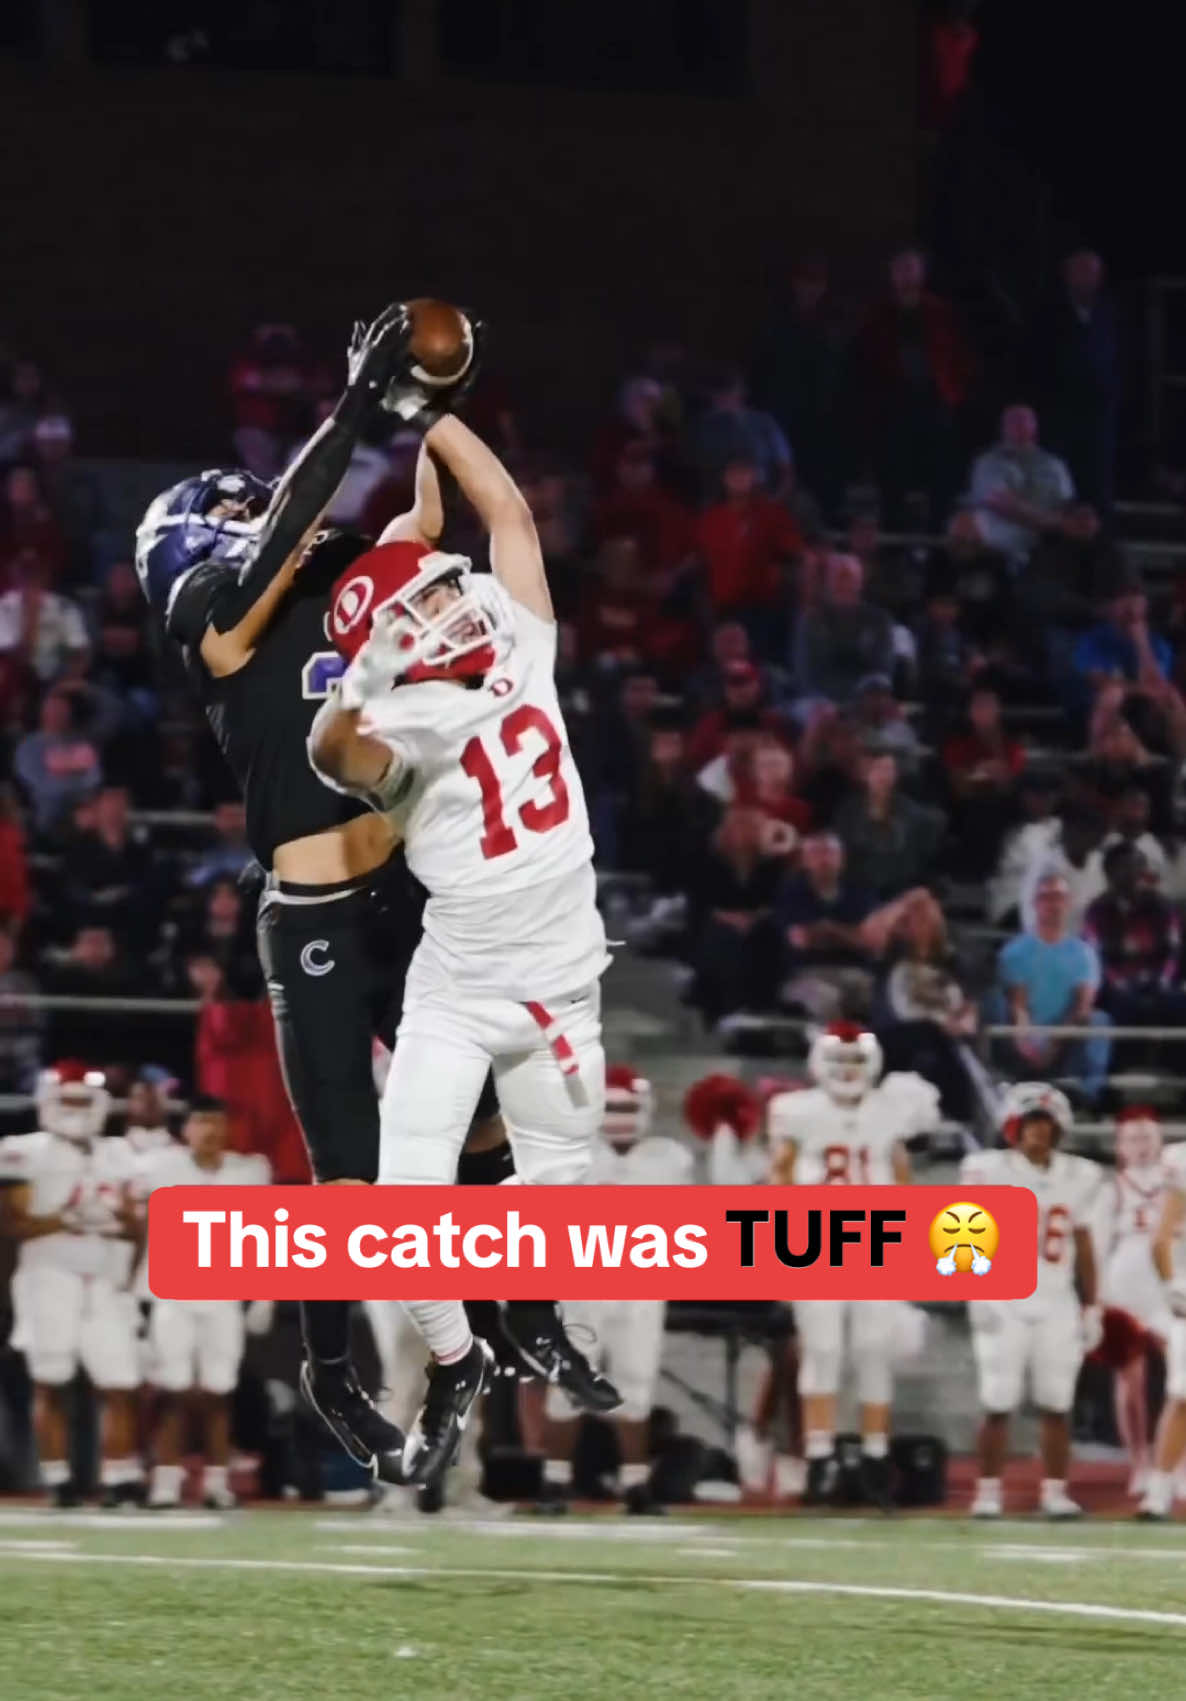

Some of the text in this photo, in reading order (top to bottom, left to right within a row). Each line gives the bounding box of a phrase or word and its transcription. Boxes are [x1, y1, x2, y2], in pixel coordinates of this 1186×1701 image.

[460, 704, 569, 860] 13
[300, 939, 335, 976] C
[1042, 1203, 1069, 1265] 6
